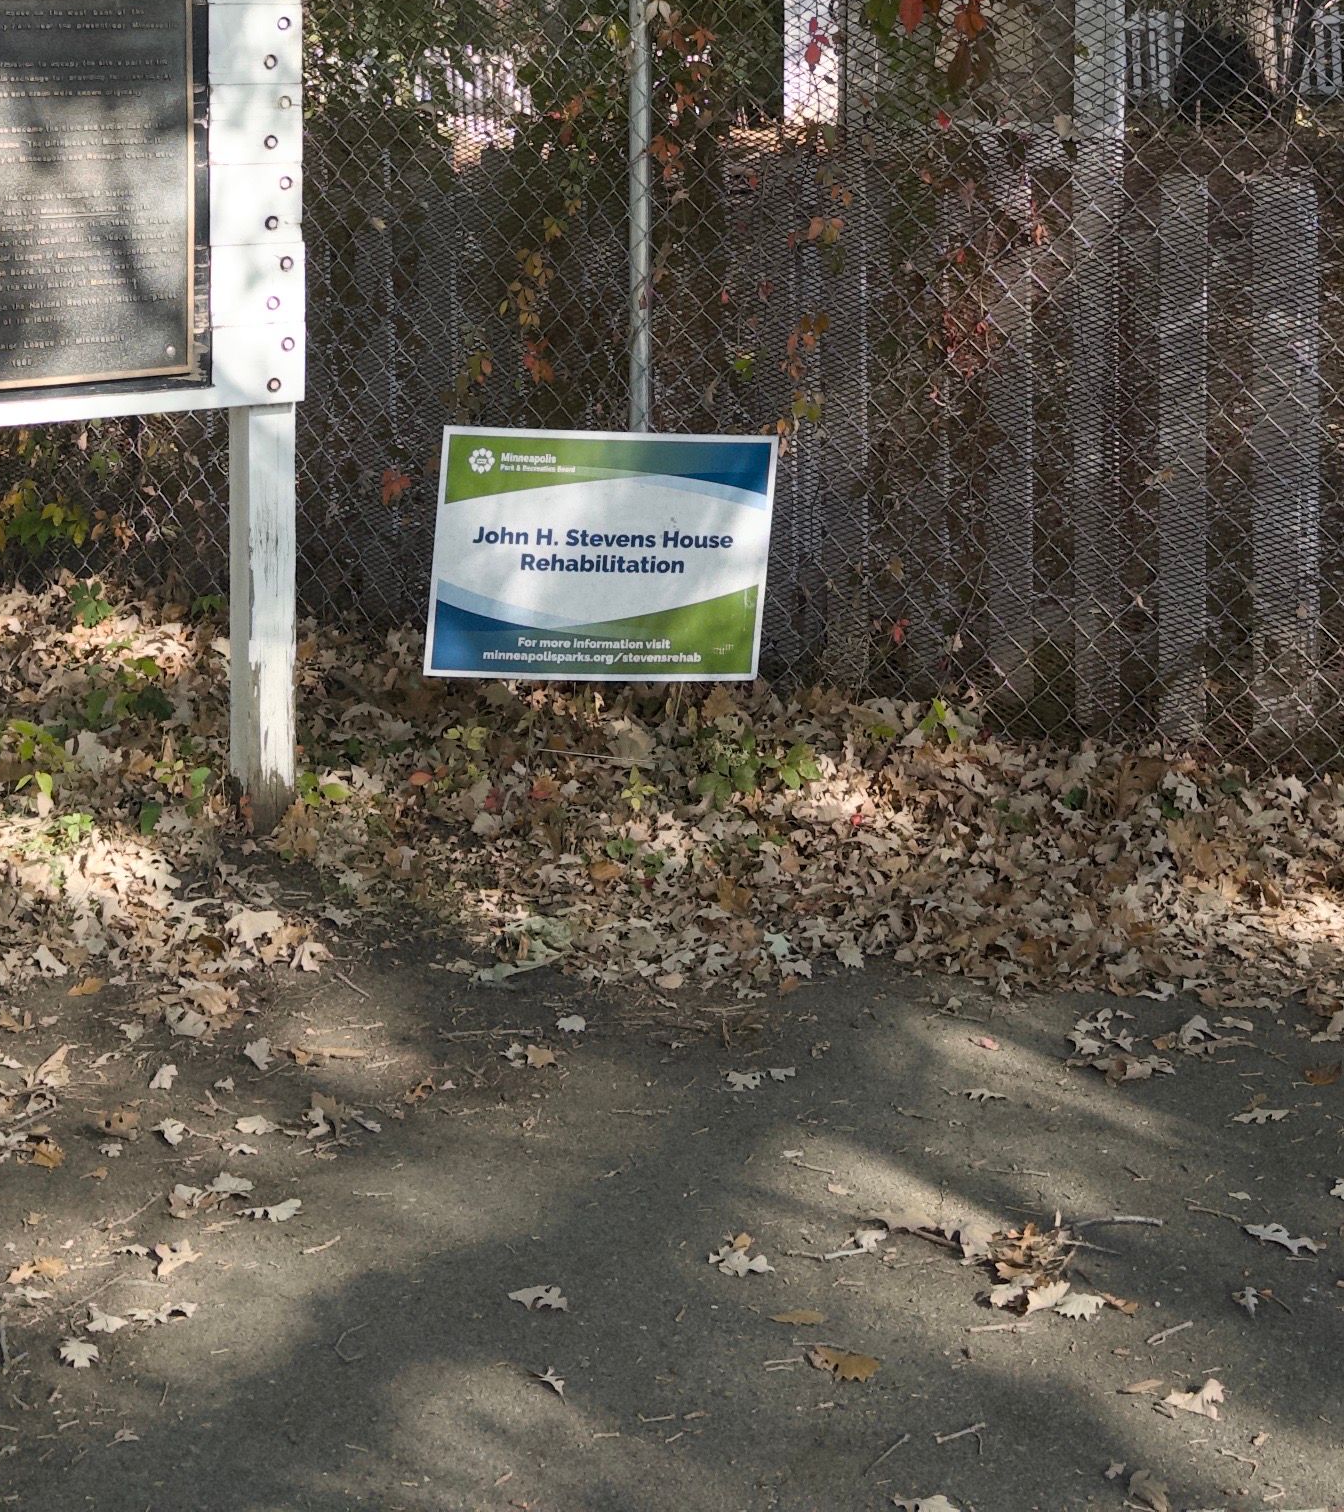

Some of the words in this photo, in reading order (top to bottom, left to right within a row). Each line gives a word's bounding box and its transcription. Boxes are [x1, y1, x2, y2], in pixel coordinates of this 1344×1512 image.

[501, 452, 557, 465] Minneapolis
[472, 526, 529, 545] John
[536, 528, 559, 546] H.
[566, 528, 656, 549] Stevens
[662, 530, 734, 549] House
[520, 553, 685, 574] Rehabilitation
[517, 637, 537, 648] For
[539, 639, 571, 649] more
[573, 638, 644, 650] information
[645, 638, 671, 650] visit
[482, 650, 702, 665] minneapolisparks.org/stevensrehab
